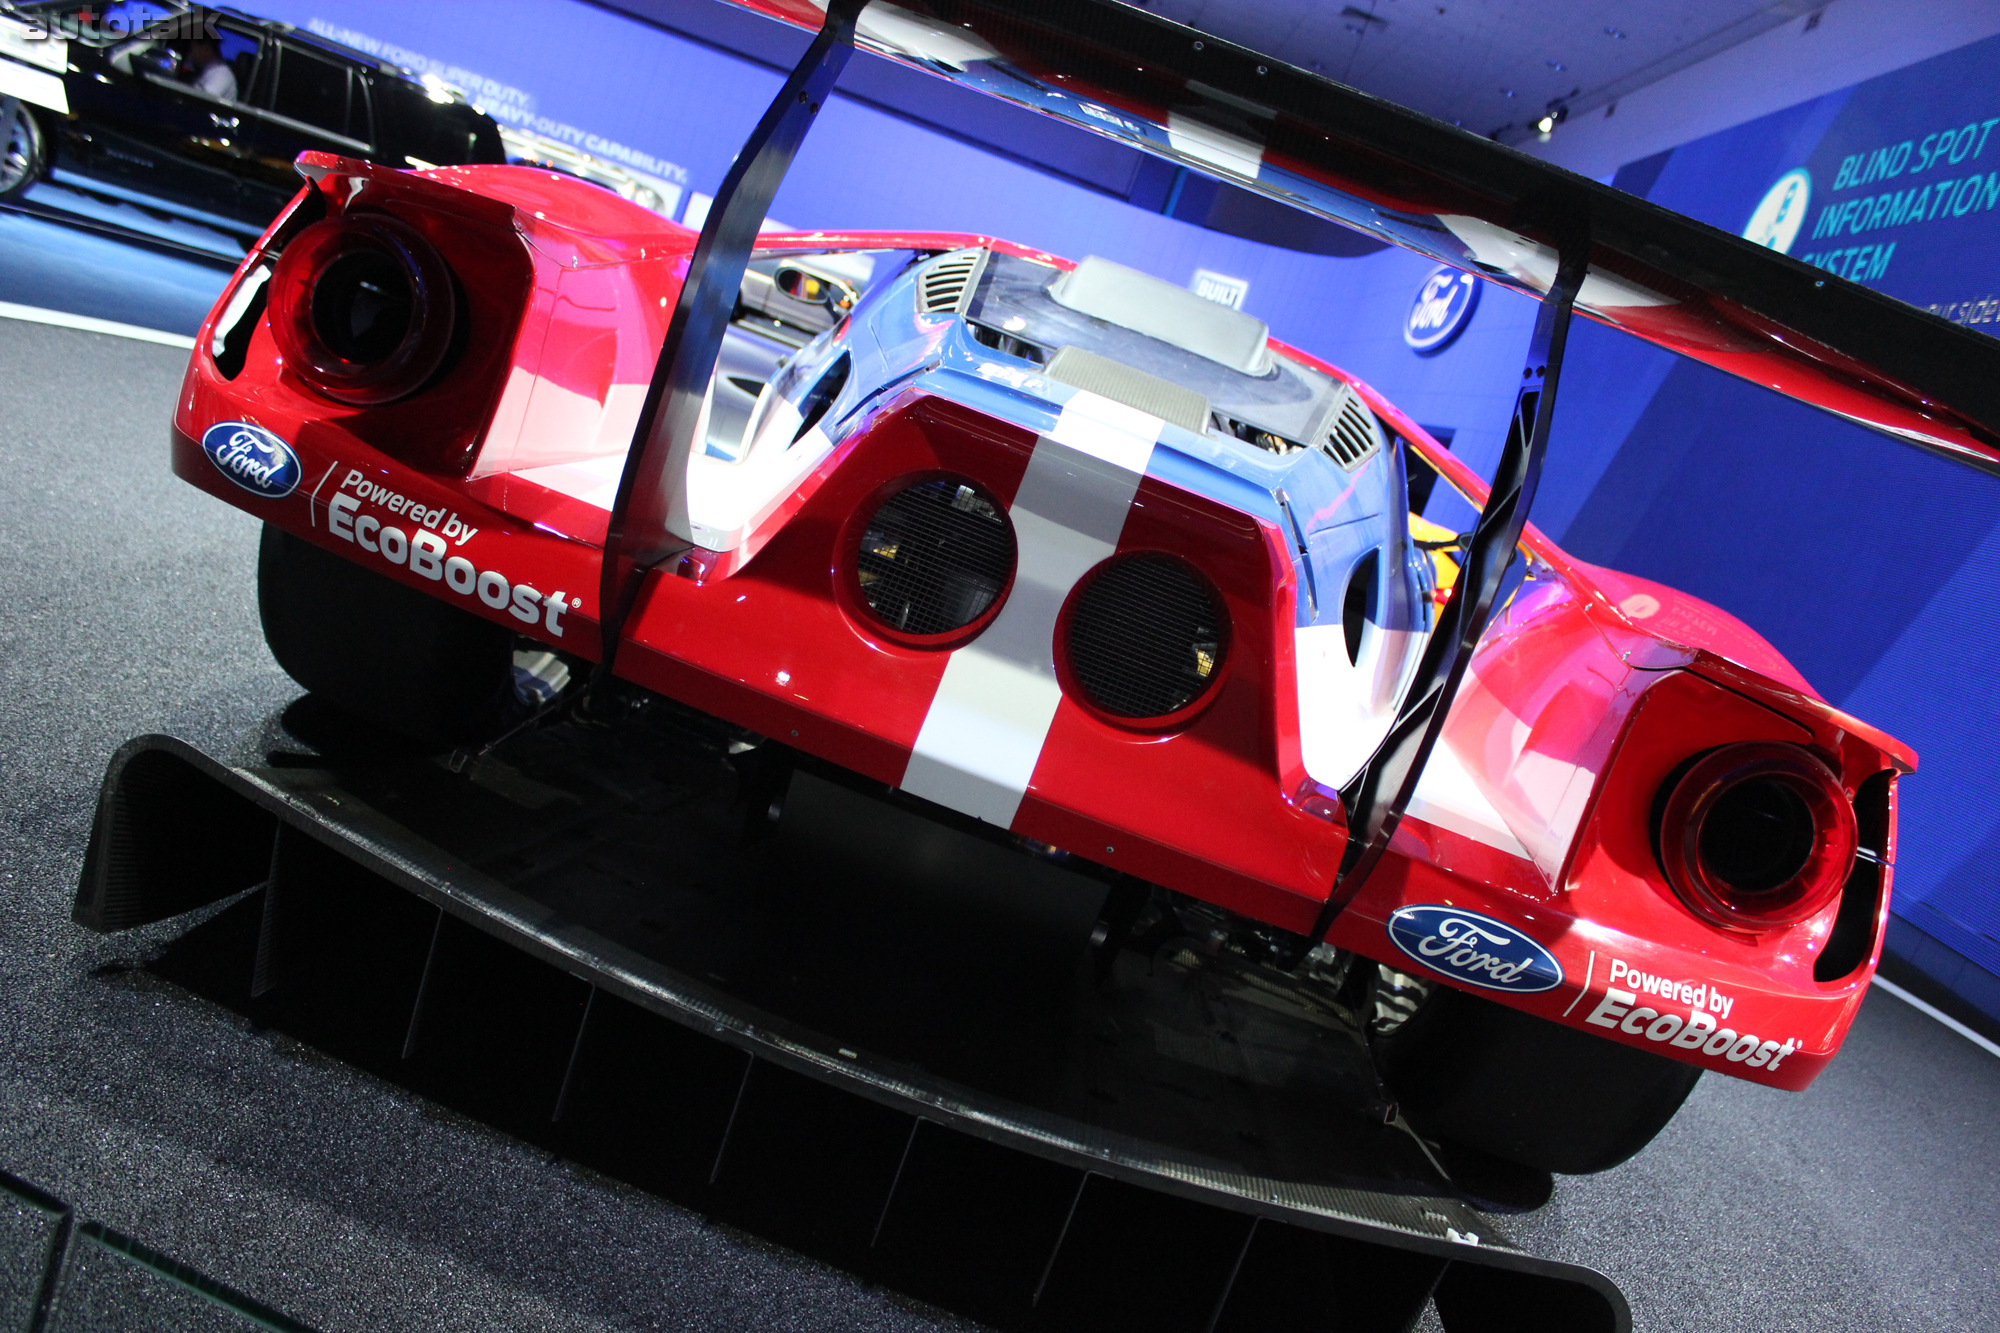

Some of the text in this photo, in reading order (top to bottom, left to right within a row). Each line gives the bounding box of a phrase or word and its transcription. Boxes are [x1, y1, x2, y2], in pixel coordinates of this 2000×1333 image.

[381, 42, 428, 71] FORD
[1833, 117, 2000, 191] BLIND SPOT
[1812, 171, 2000, 241] INFORMATION
[1197, 278, 1240, 307] BUILT
[1410, 273, 1459, 330] Ford
[216, 430, 285, 489] Ford
[340, 469, 478, 546] Powered by
[1417, 917, 1534, 985] Ford
[1609, 958, 1734, 1020] Powered by
